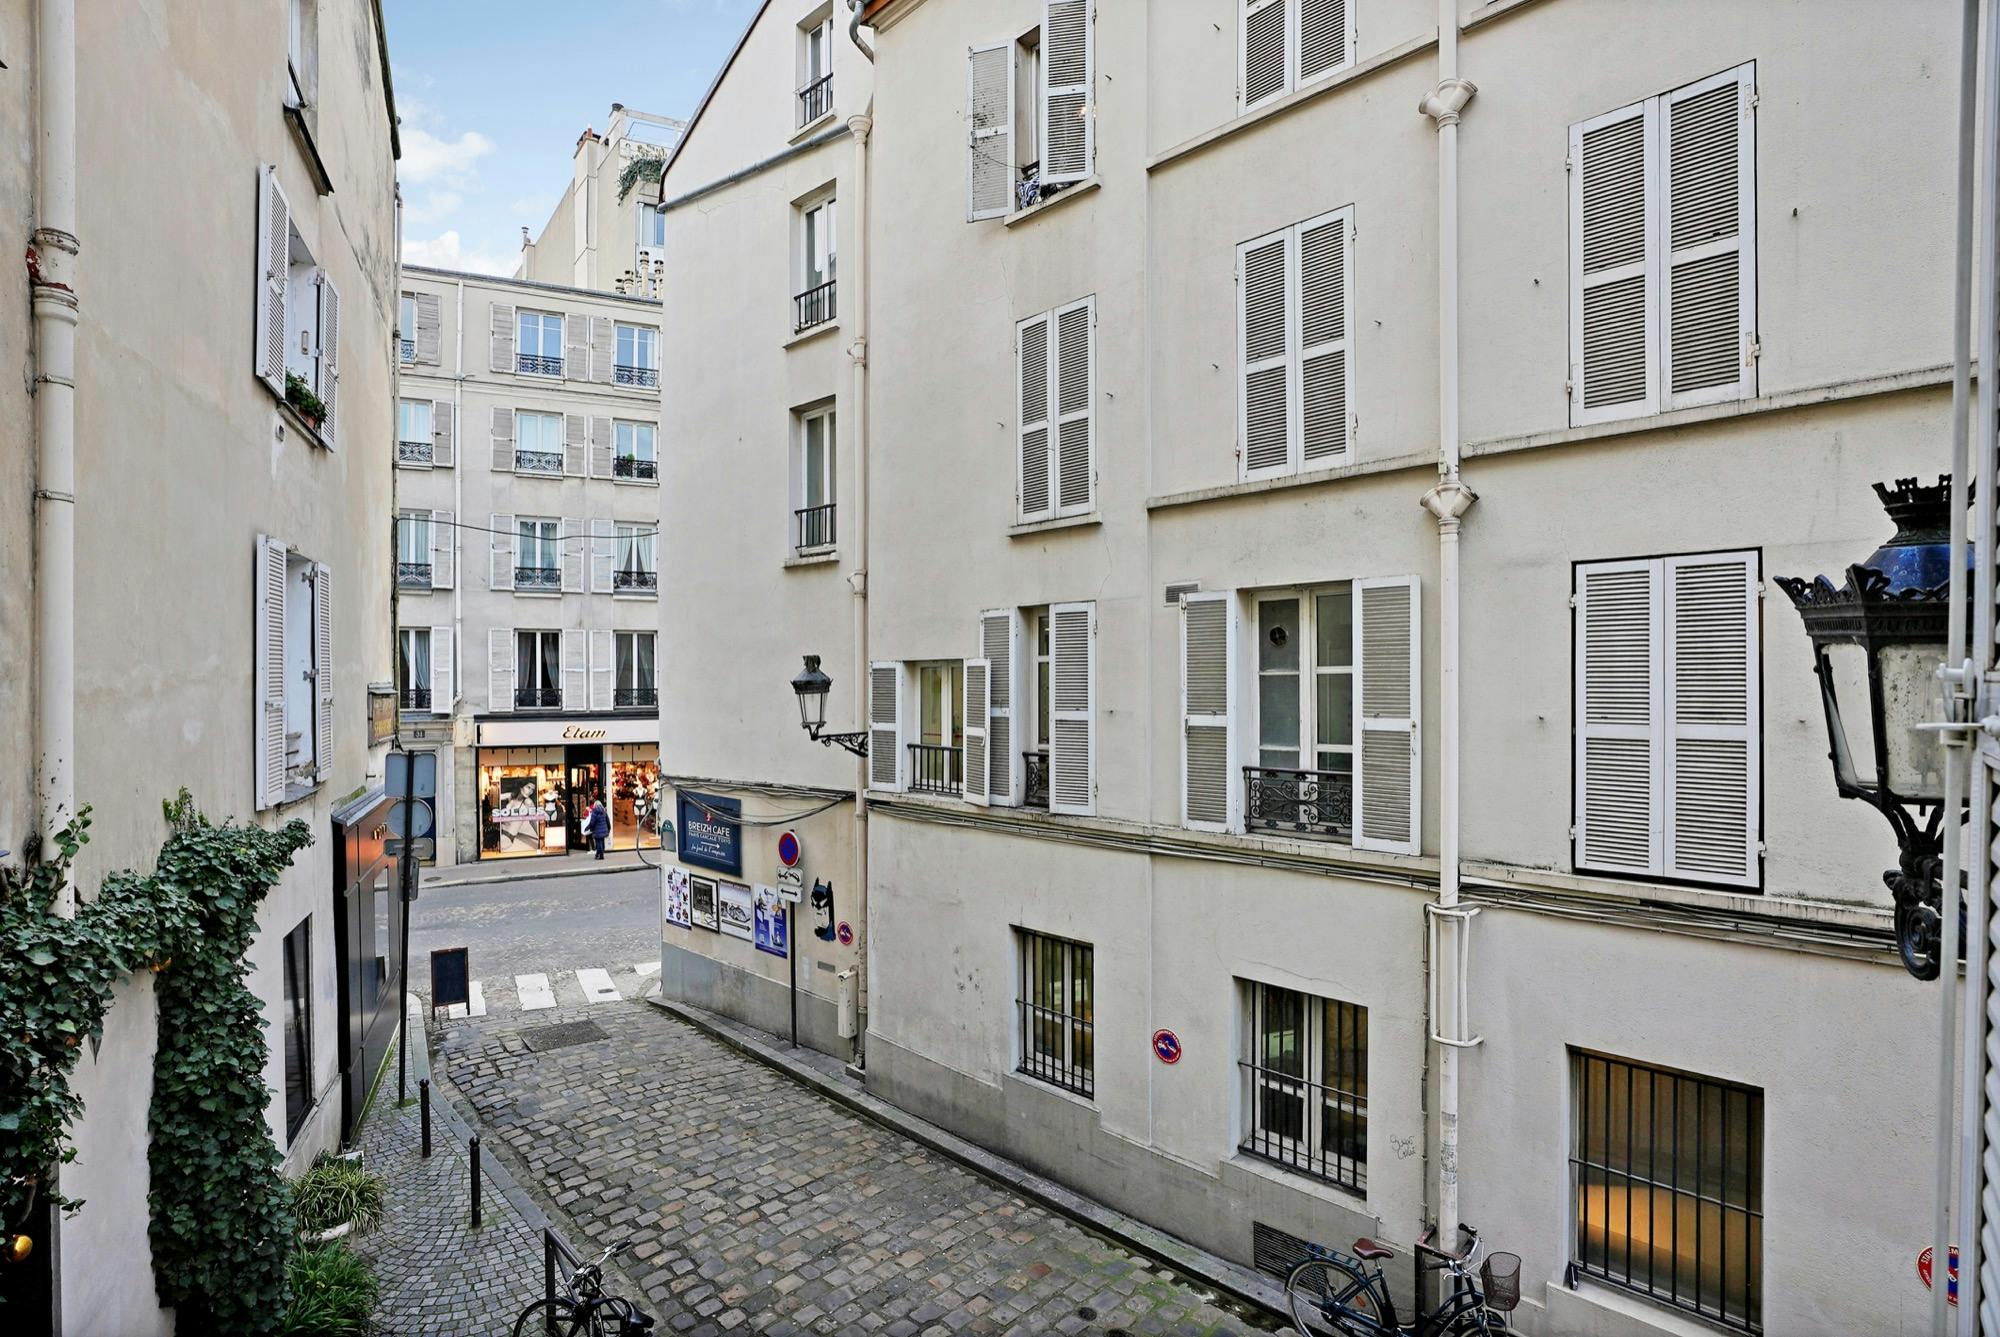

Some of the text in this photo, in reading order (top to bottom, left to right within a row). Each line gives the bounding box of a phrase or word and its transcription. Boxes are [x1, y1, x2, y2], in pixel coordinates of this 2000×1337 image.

[562, 725, 606, 739] Etam
[491, 806, 546, 817] SOLDES
[688, 821, 730, 837] BREIZH CAFE
